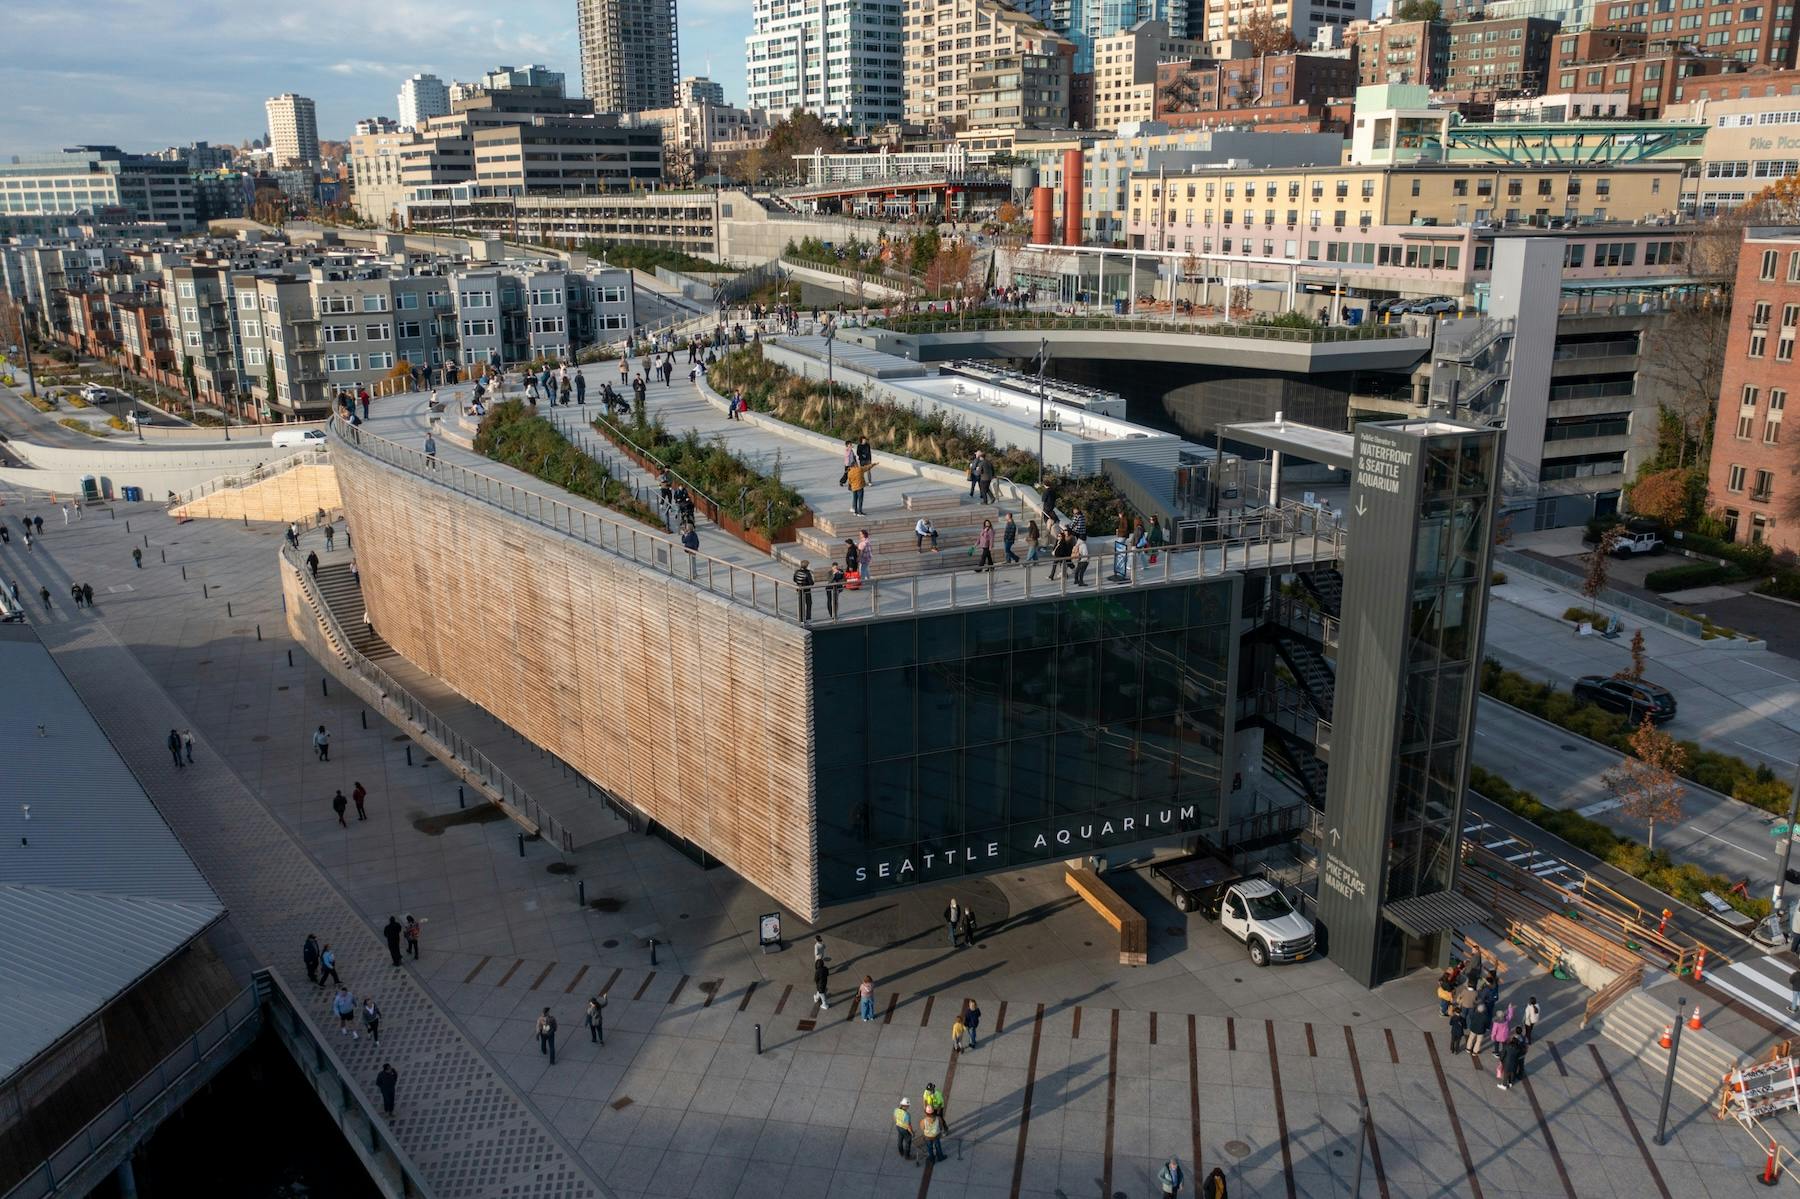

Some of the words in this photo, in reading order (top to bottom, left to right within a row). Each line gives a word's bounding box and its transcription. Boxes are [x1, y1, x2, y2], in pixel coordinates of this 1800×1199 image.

[1749, 136, 1773, 150] Pike
[1360, 441, 1412, 465] WATERFRONT
[1358, 457, 1365, 470] &
[1365, 458, 1400, 478] SEATTLE
[1357, 471, 1400, 494] AQUARIUM
[855, 842, 999, 882] SEATTLE
[1033, 805, 1196, 848] AQUARIUM
[1325, 872, 1354, 900] MARKET
[1326, 860, 1343, 880] PIKE
[1343, 871, 1366, 896] PLACE
